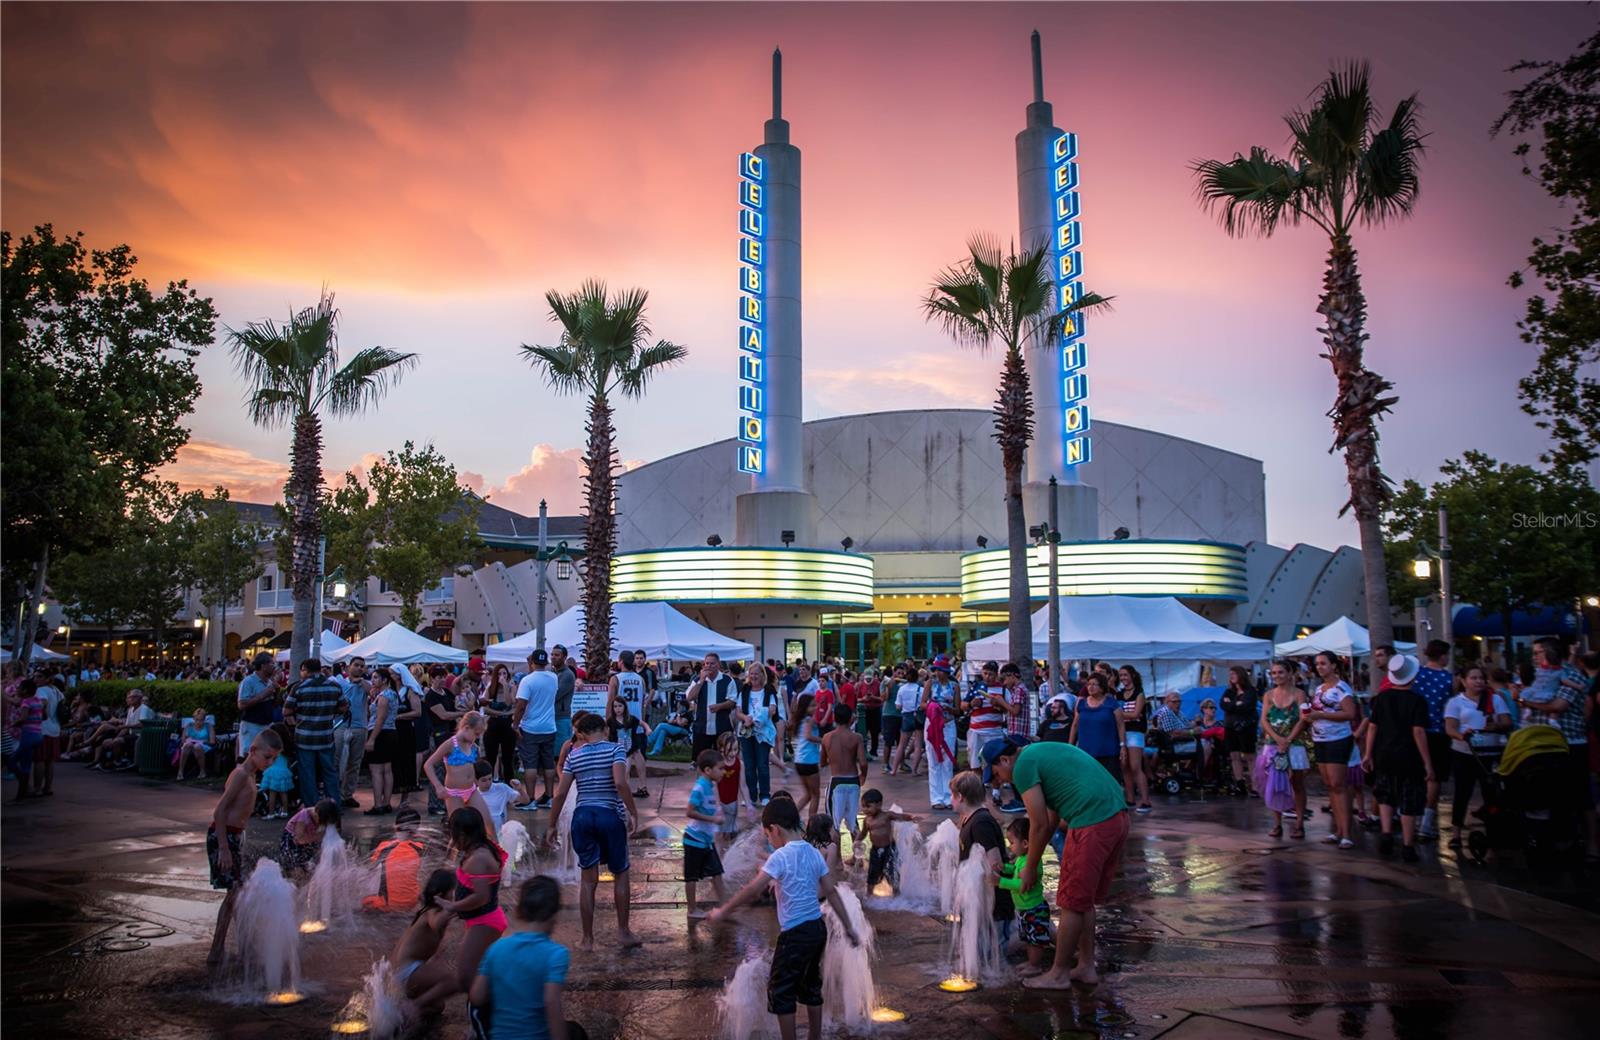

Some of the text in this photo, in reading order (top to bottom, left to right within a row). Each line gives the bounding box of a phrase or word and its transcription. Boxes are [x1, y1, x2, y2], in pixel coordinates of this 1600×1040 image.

[744, 155, 762, 472] CELEBRATION
[1055, 136, 1082, 463] CELEBRATION
[623, 687, 639, 702] 31
